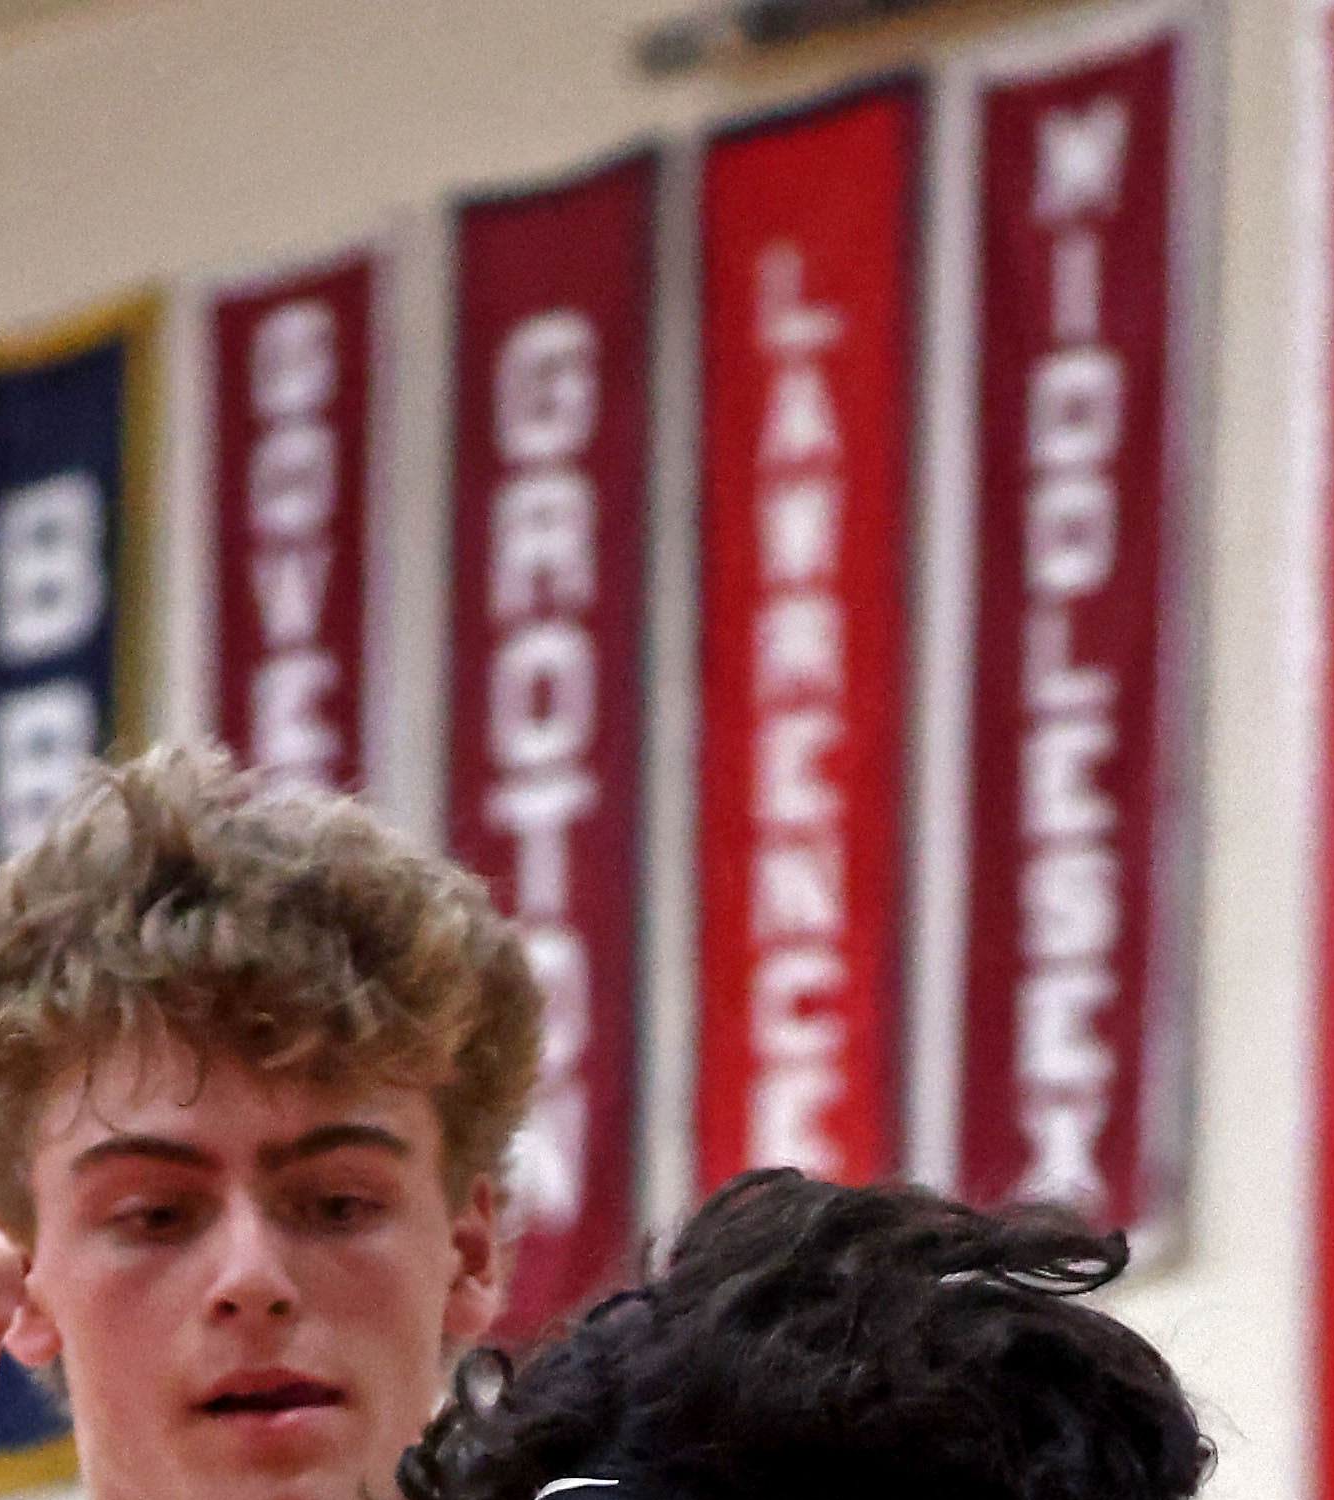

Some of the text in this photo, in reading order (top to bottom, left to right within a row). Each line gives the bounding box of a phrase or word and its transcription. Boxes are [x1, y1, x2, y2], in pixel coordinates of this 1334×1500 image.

[247, 300, 341, 798] GOVE
[482, 308, 601, 1236] GROTON
[745, 236, 851, 1178] LAWRENCE
[1015, 92, 1127, 1212] MIDDLESEX
